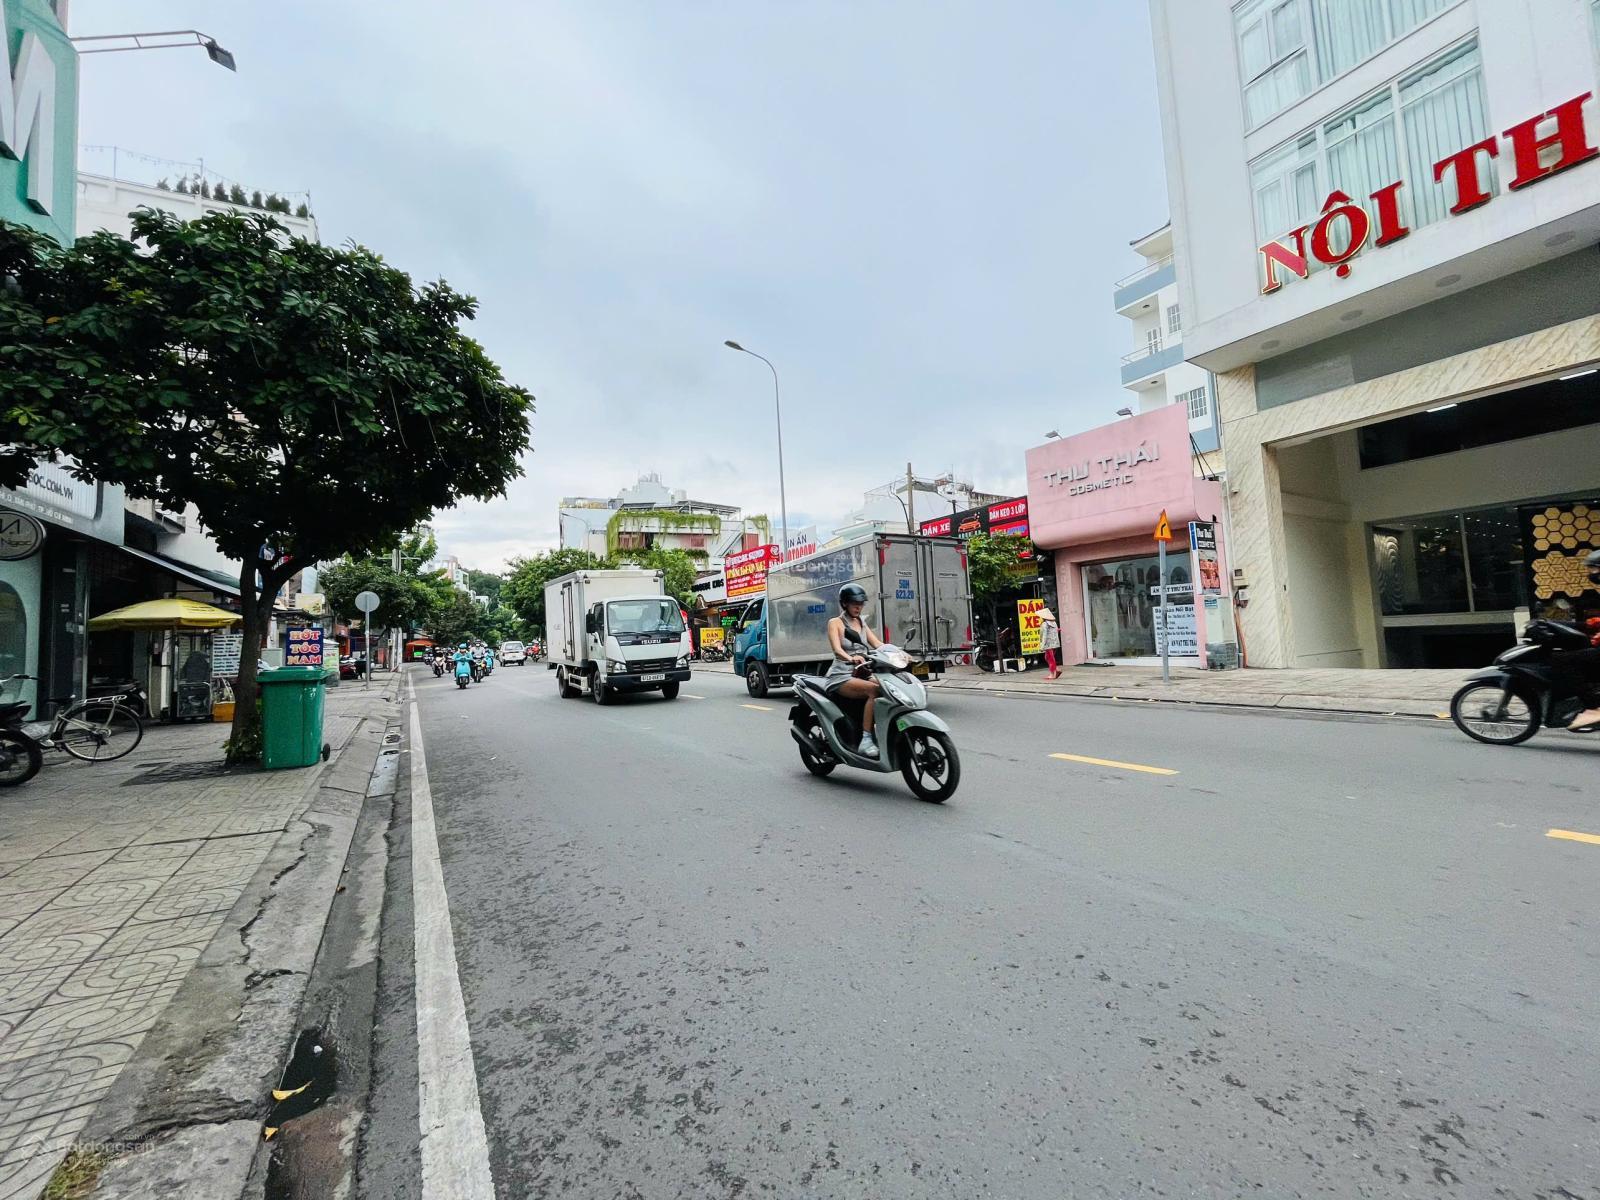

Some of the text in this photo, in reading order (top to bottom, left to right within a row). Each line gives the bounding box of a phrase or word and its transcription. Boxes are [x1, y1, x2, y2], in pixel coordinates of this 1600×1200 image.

[1258, 180, 1410, 296] NỘI
[1097, 439, 1160, 474] THÁI
[1069, 475, 1134, 496] COSMETIC
[1010, 506, 1015, 515] 3
[922, 522, 951, 536] DÁN XE
[787, 538, 795, 548] IN
[1019, 601, 1044, 614] DÁN
[1024, 616, 1041, 629] XE
[289, 629, 322, 641] HỚT
[290, 642, 321, 654] TÓC
[286, 655, 322, 665] NAM
